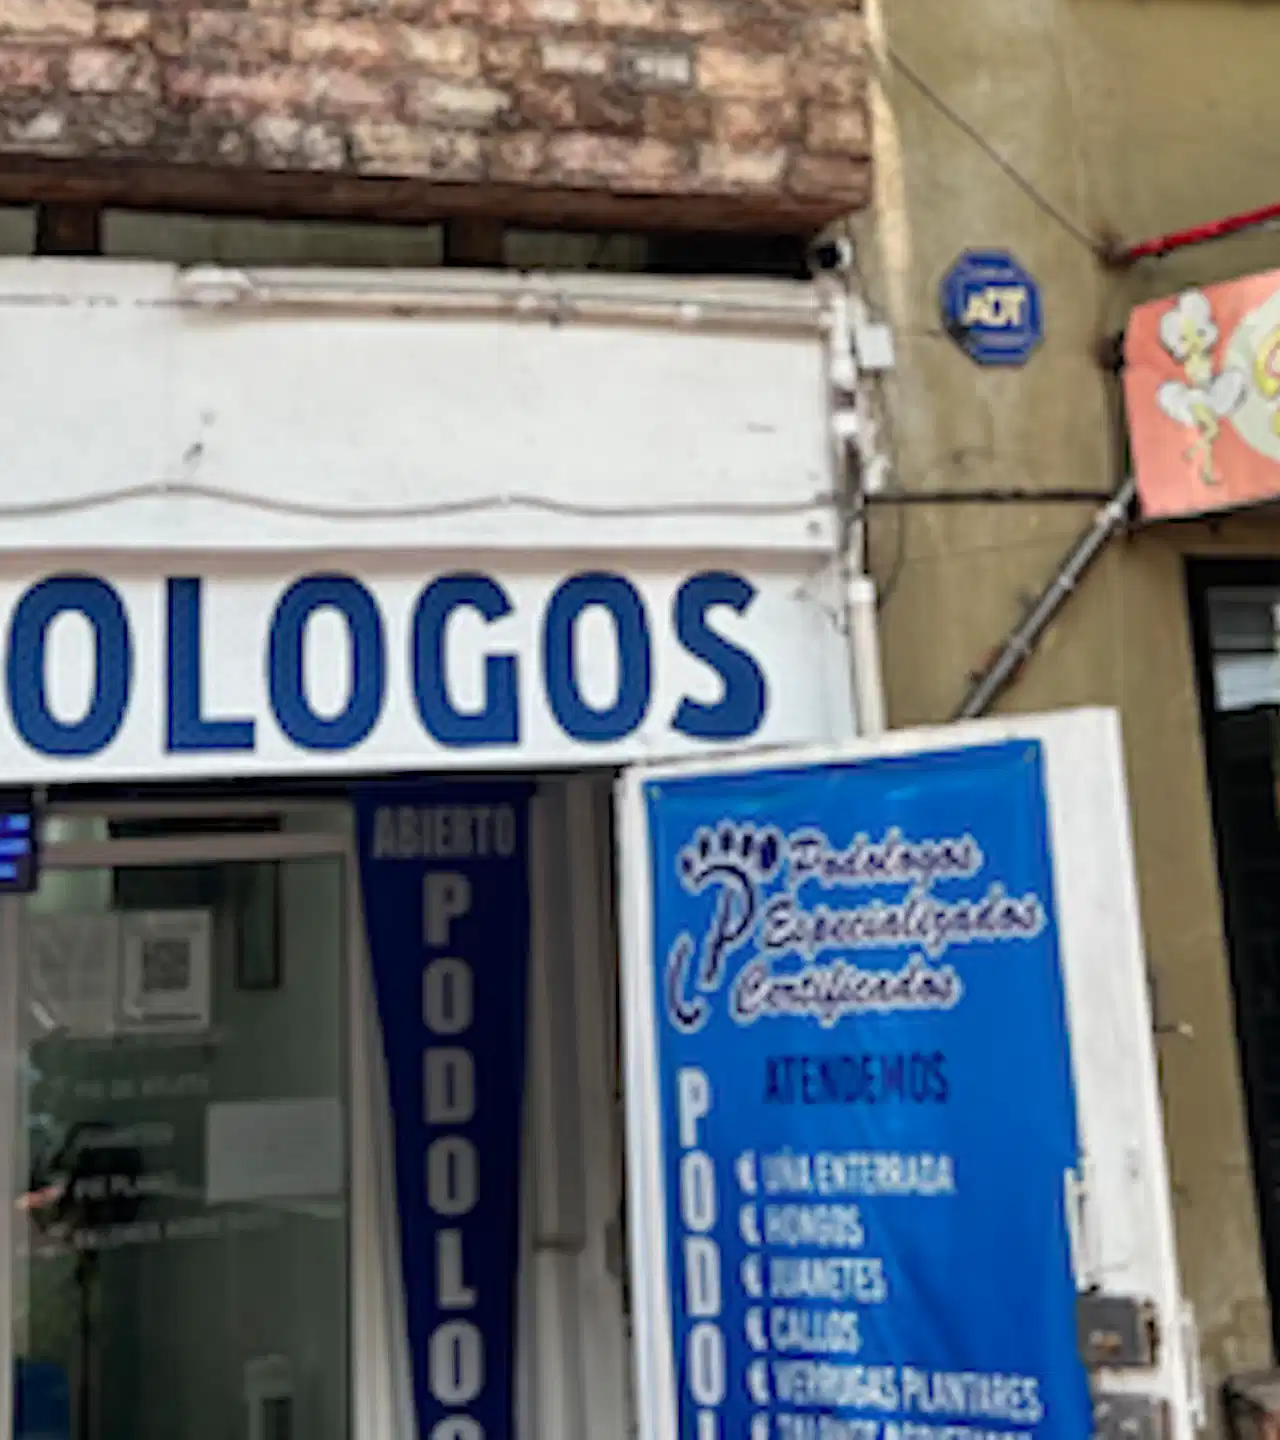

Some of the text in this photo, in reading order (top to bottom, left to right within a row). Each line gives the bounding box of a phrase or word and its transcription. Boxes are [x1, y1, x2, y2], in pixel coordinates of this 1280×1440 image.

[963, 285, 1025, 327] ADT
[373, 804, 517, 858] ABIERTO
[763, 1053, 951, 1106] ATENDEMOS
